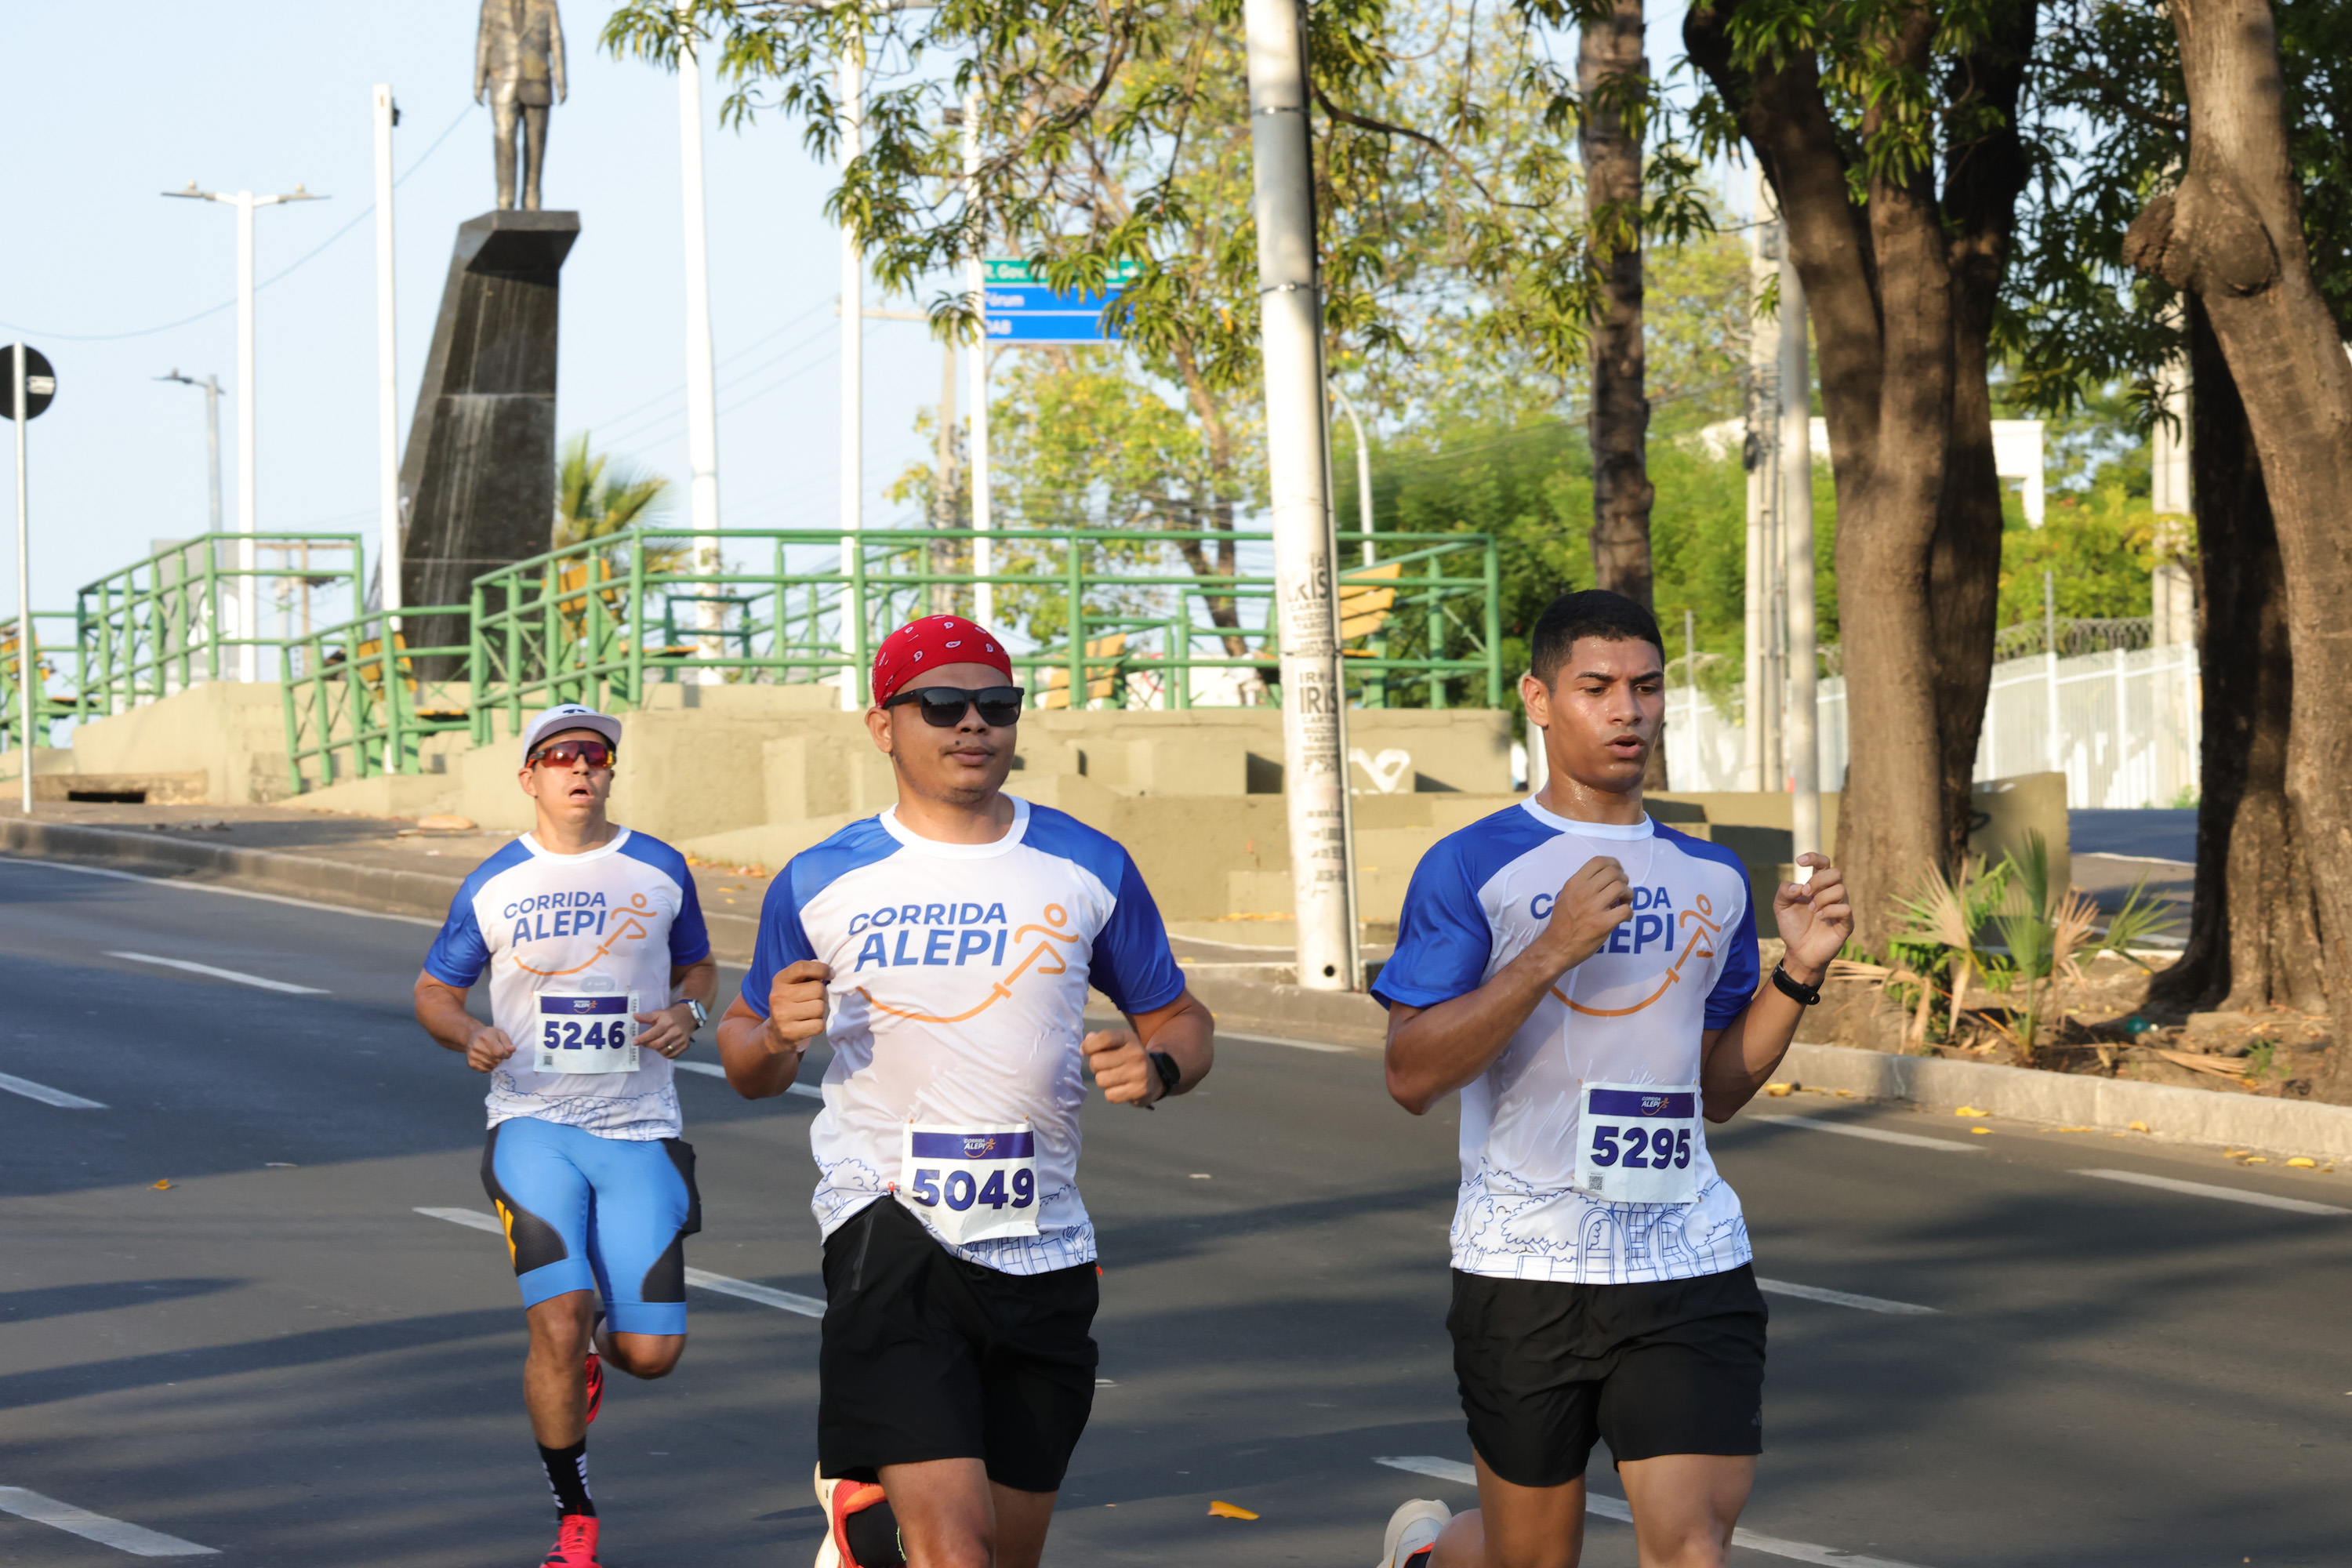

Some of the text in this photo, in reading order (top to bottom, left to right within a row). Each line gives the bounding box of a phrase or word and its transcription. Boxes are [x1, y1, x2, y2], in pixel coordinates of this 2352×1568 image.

[504, 891, 606, 919] CORRIDA
[848, 902, 1007, 935] CORRIDA
[512, 910, 607, 948] ALEPI
[854, 928, 1007, 972] ALEPI
[543, 1021, 626, 1050] 5246
[1590, 1125, 1690, 1170] 5295
[912, 1168, 1034, 1211] 5049
